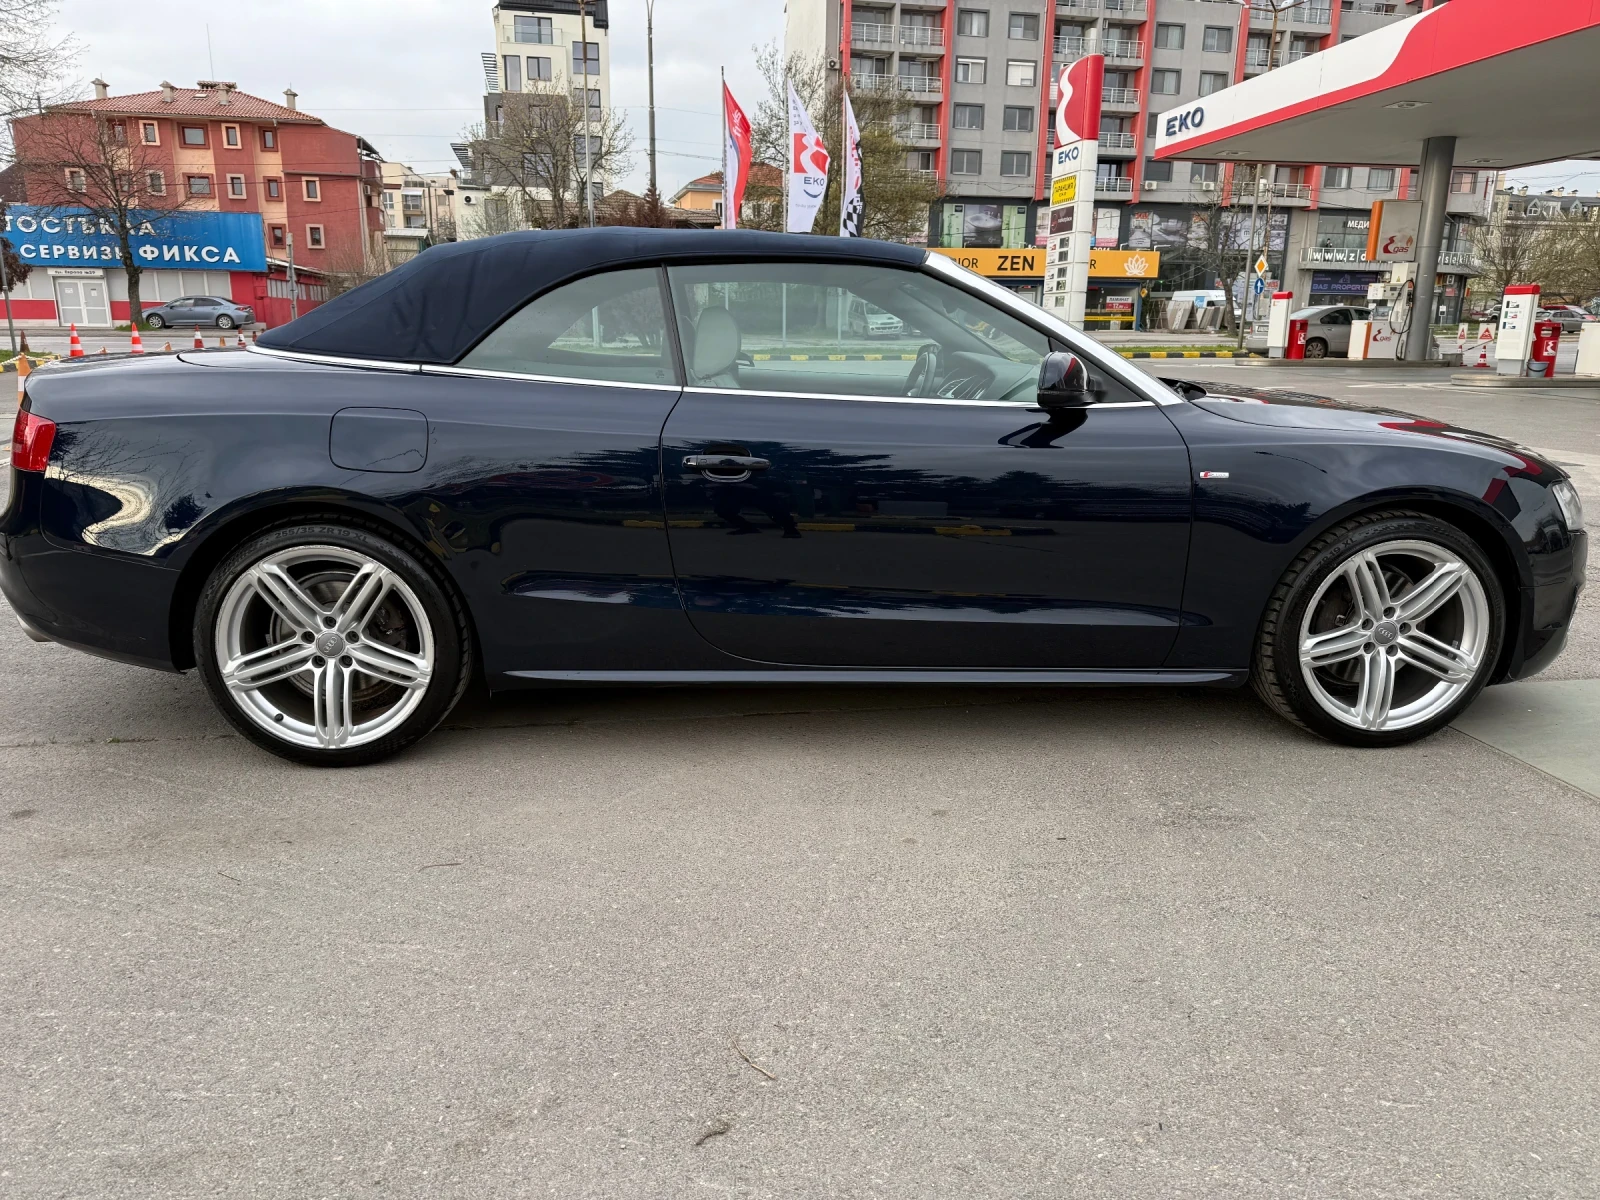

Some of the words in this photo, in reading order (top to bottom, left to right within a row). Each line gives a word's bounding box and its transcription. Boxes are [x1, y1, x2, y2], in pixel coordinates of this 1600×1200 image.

[1165, 106, 1204, 137] EKO
[1057, 146, 1080, 165] EKO
[803, 176, 825, 187] EKO
[138, 244, 242, 263] ФИКСА
[951, 257, 979, 269] IOR
[996, 255, 1035, 271] ZEN
[337, 529, 351, 537] 19
